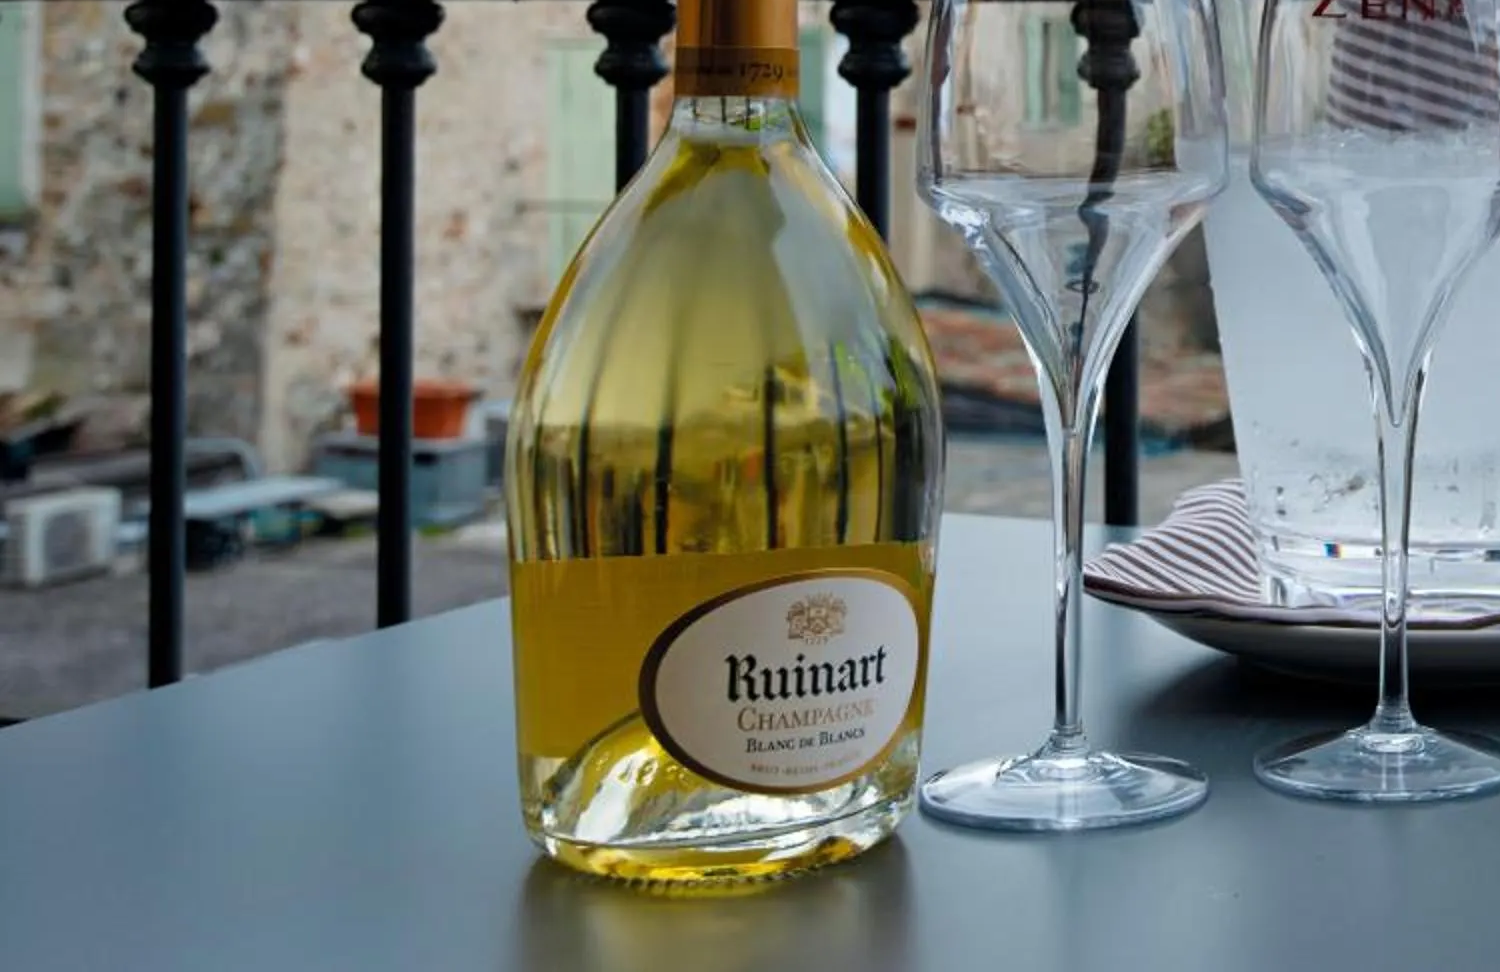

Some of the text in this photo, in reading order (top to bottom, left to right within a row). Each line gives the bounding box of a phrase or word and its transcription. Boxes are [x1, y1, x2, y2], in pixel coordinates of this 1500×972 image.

[740, 62, 783, 84] 1729
[725, 645, 886, 702] Ruinart
[737, 699, 875, 732] CHAMPAGNE
[745, 737, 795, 753] BLANC
[819, 728, 866, 746] BLANCS
